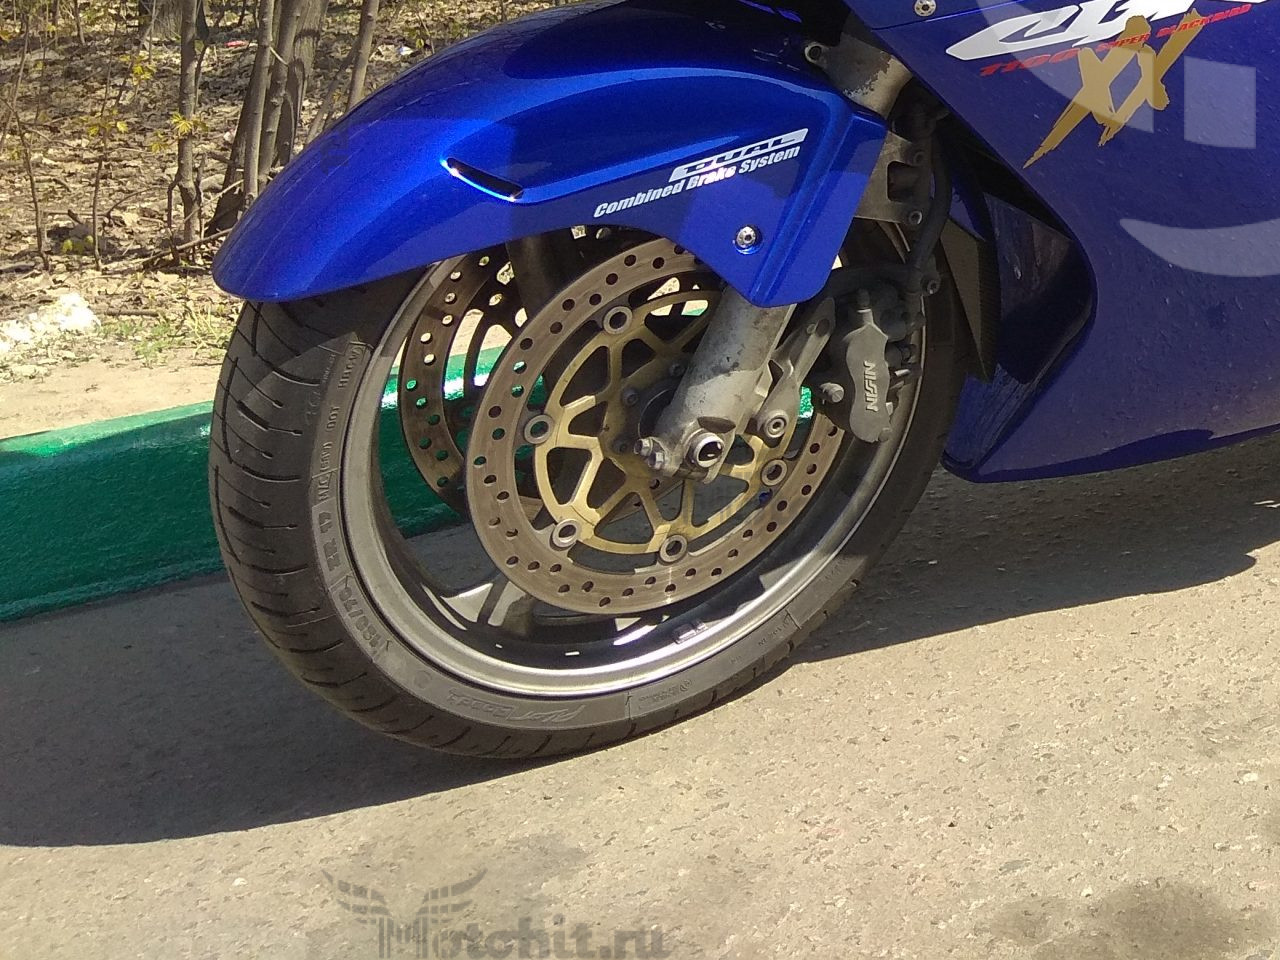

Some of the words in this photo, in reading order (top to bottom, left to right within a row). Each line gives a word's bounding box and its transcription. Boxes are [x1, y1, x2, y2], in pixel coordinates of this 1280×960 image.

[979, 47, 1081, 77] 1100
[1096, 32, 1151, 53] SUPER
[1156, 3, 1252, 38] BLACKBIRD
[593, 180, 684, 218] Combined
[685, 165, 737, 189] Brake
[738, 145, 800, 175] System
[863, 360, 879, 412] NISSIN
